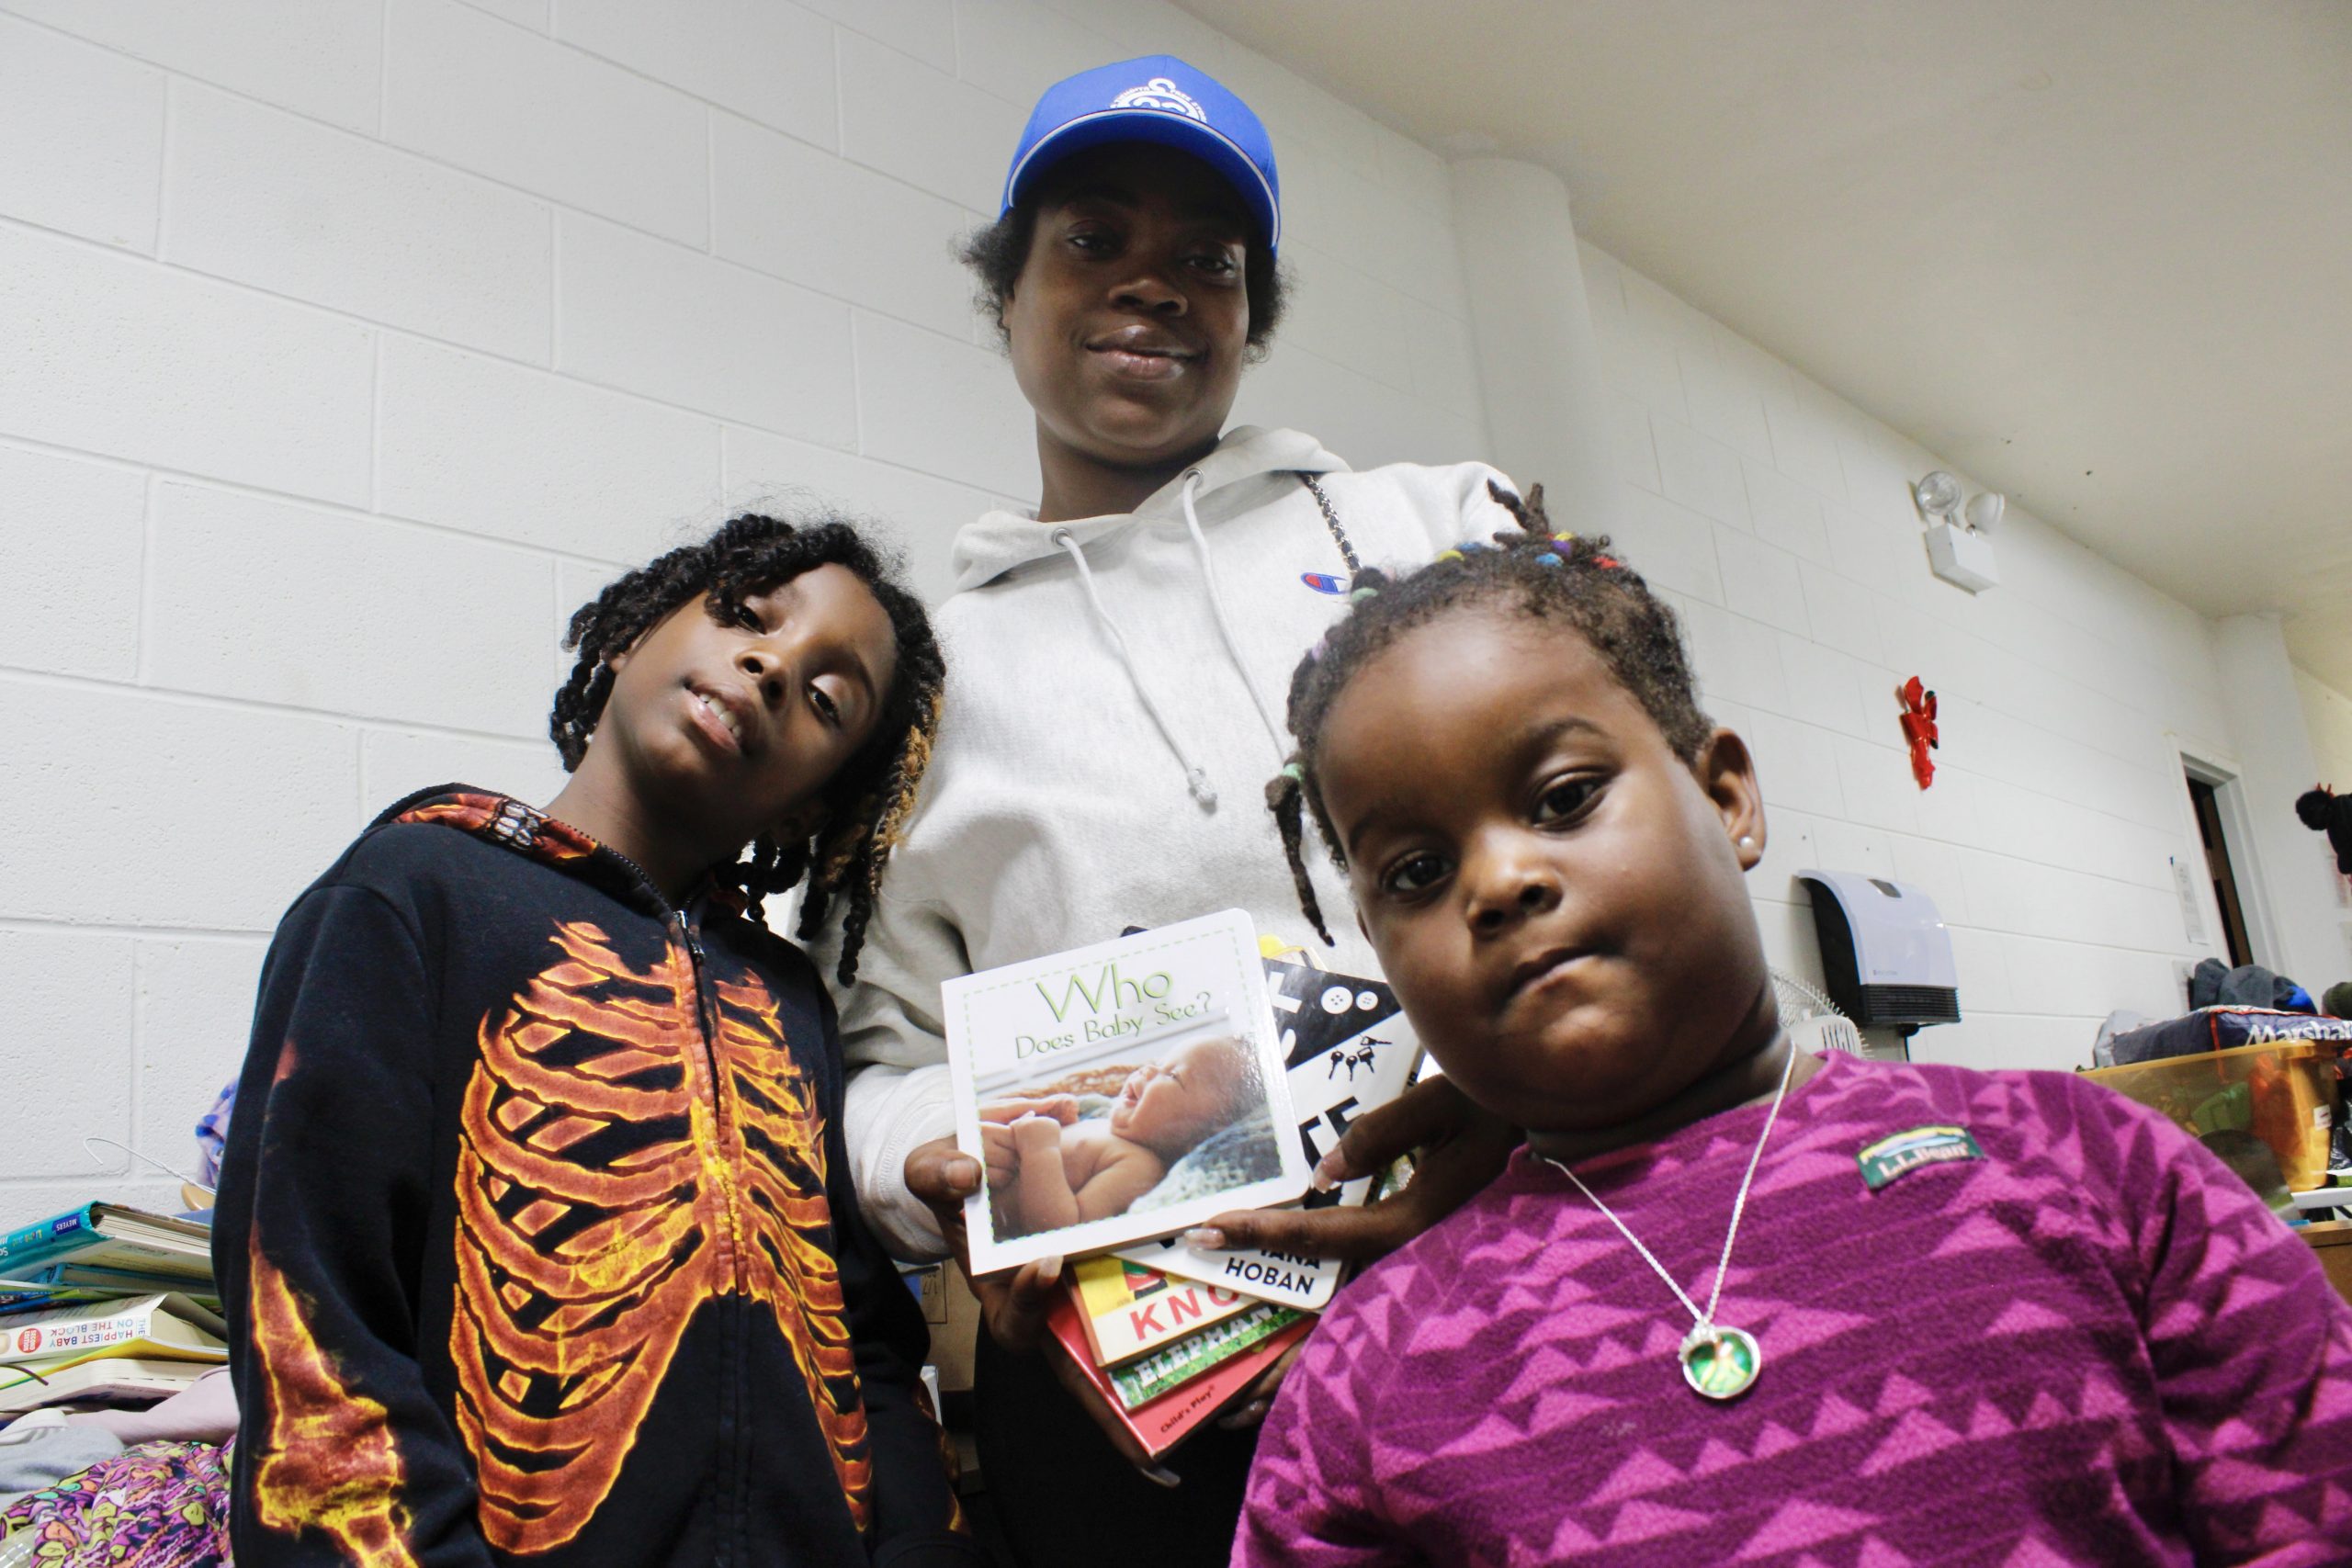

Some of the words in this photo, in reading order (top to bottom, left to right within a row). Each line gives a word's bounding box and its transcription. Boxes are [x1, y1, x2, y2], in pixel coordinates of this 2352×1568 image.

[1035, 963, 1174, 1022] Who
[1015, 1033, 1075, 1059] Does
[1084, 1013, 1144, 1043] Baby
[1154, 991, 1211, 1026] See?
[2245, 1021, 2352, 1046] Marshal
[56, 1218, 77, 1231] MEYERS
[1225, 1256, 1315, 1295] HOBAN
[51, 1324, 87, 1337] BLOCK
[92, 1321, 113, 1331] THE
[117, 1319, 133, 1328] ON
[49, 1336, 78, 1348] BABY
[81, 1329, 133, 1344] HAPPIEST
[1134, 1304, 1285, 1388] ELEPHAN
[1160, 1408, 1192, 1433] Child's
